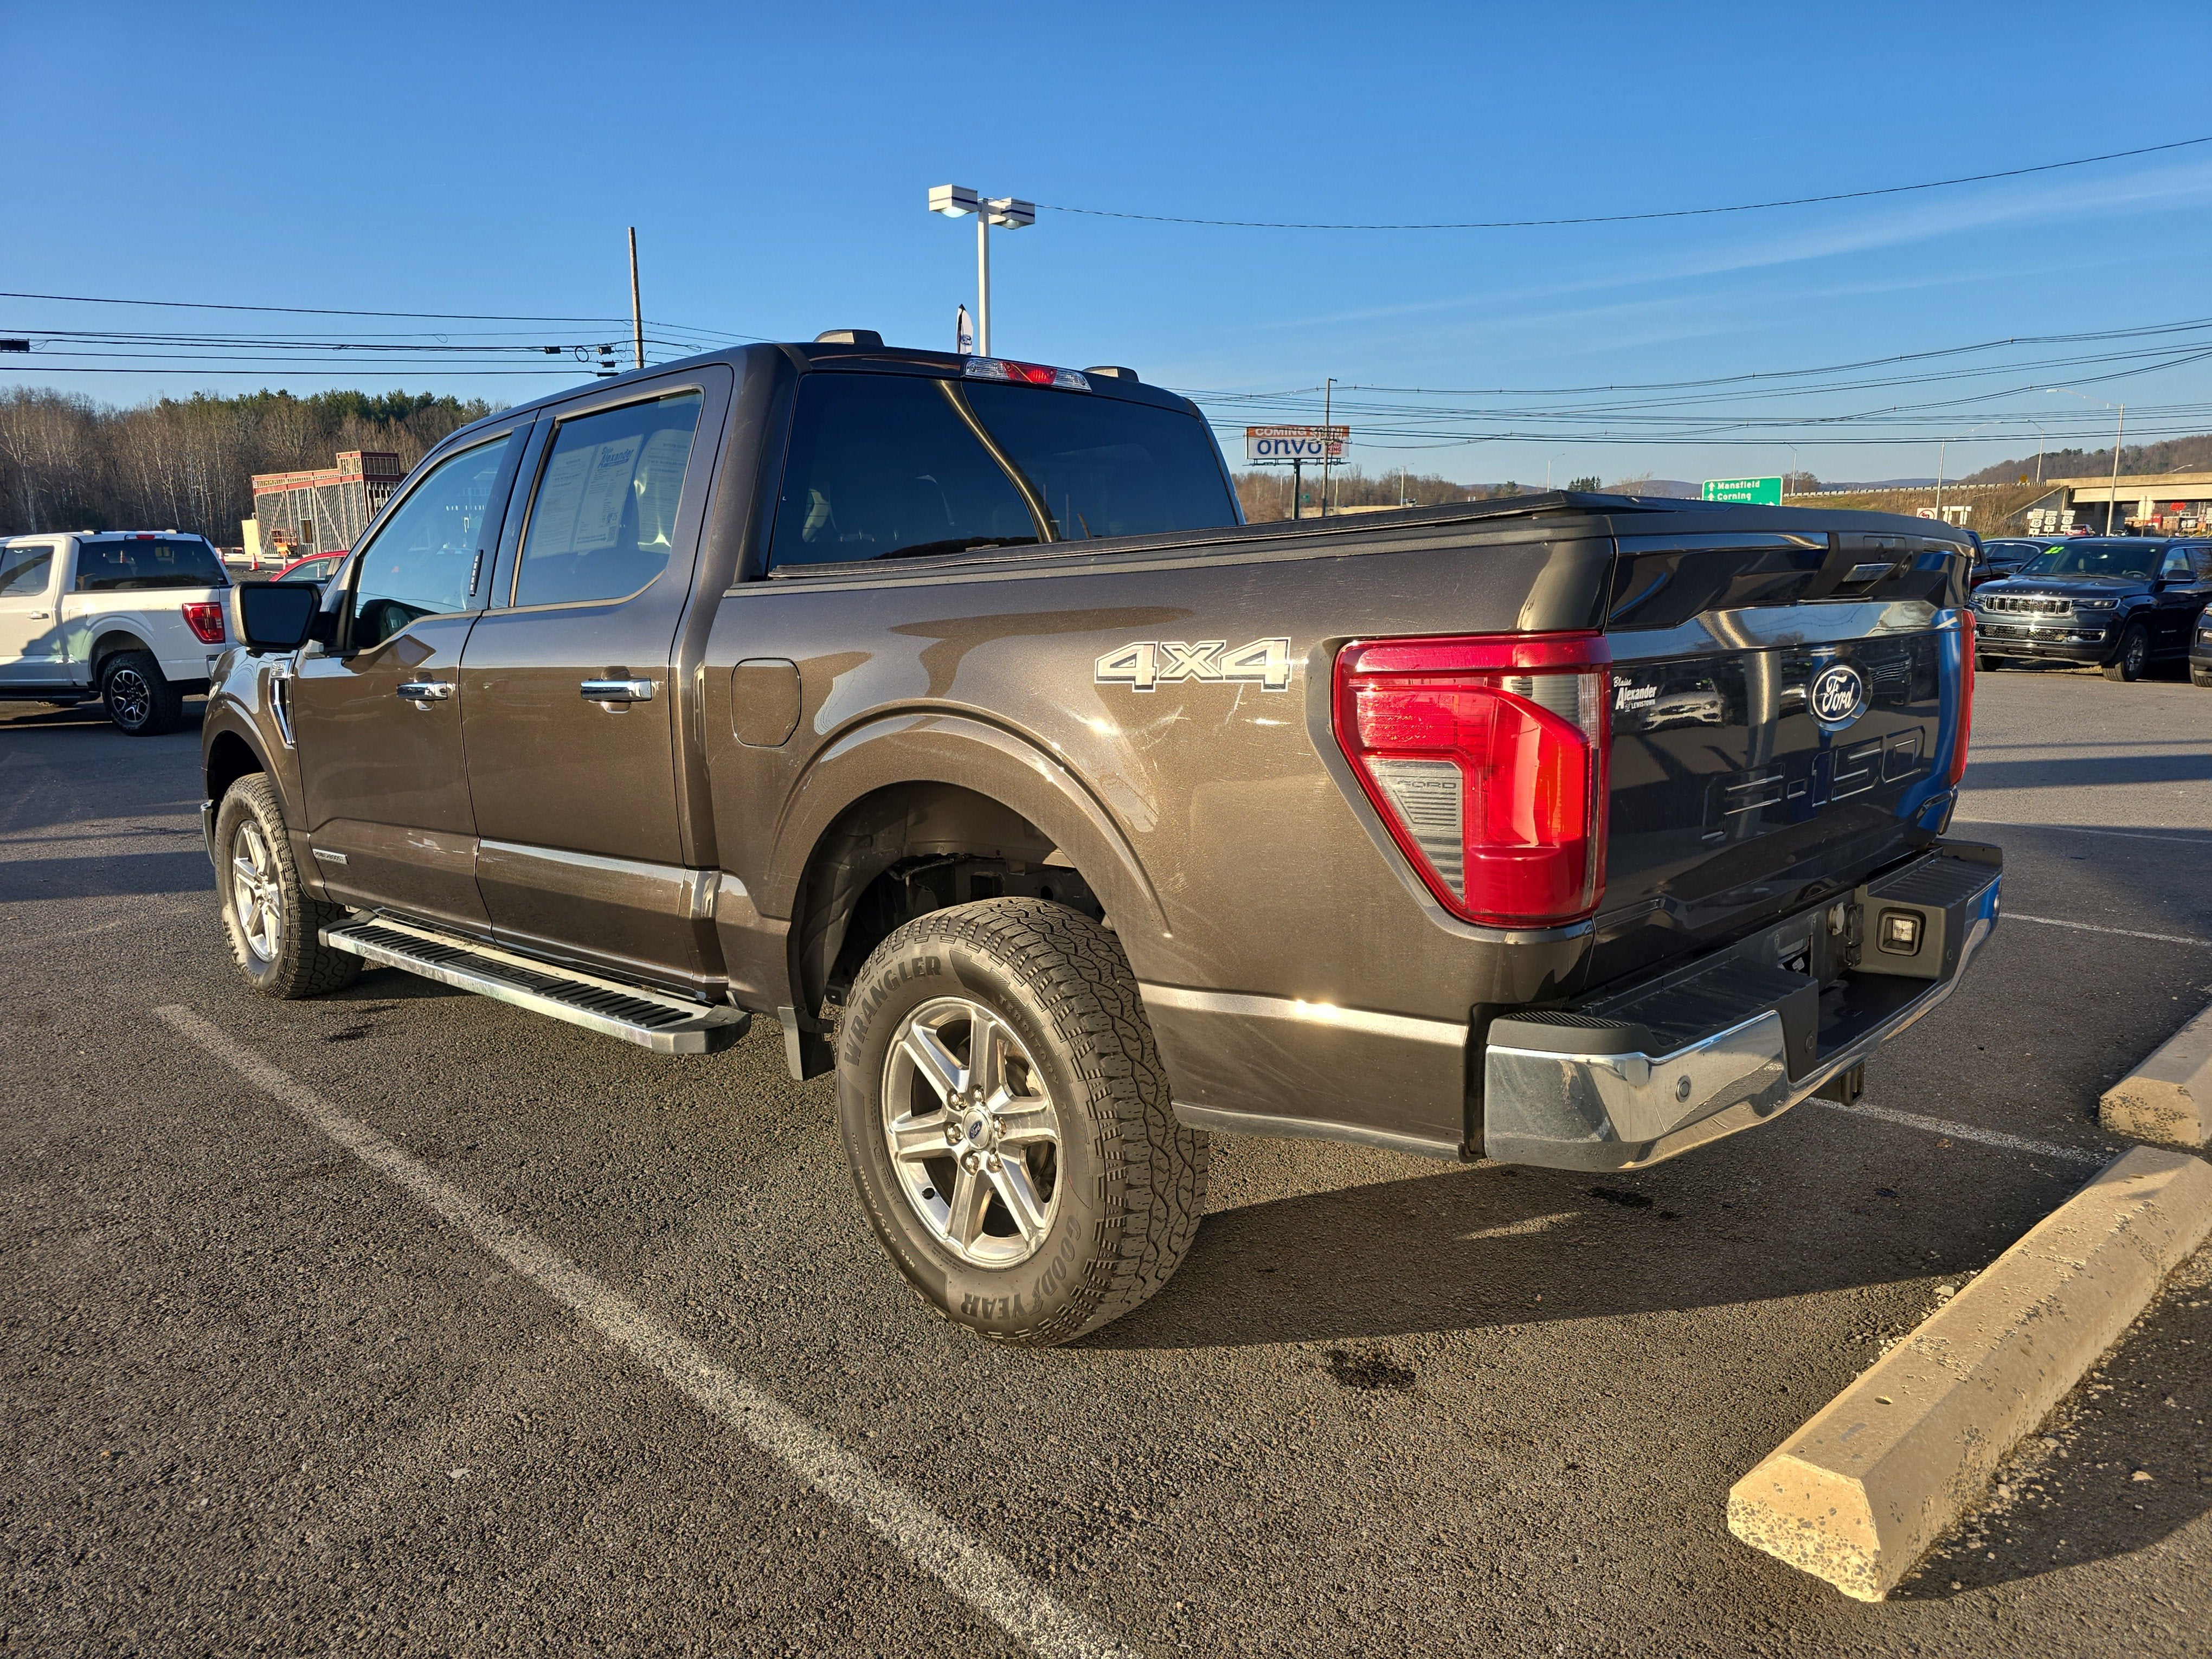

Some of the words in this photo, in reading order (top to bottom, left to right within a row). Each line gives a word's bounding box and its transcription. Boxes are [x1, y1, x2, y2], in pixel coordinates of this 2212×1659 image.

[1255, 427, 1307, 436] COMING
[1257, 439, 1322, 454] onvo
[1718, 480, 1760, 490] Mansfield
[1717, 492, 1751, 501] Corning
[1613, 676, 1632, 687] Blaise
[1615, 684, 1657, 710] Alexander
[1822, 675, 1855, 713] Ford
[1398, 780, 1456, 789] FORD
[1701, 725, 1926, 840] F-150
[844, 956, 942, 1066] WRANGLER
[1000, 994, 1059, 1084] TERRITORY
[858, 1165, 897, 1244] 275/65R18
